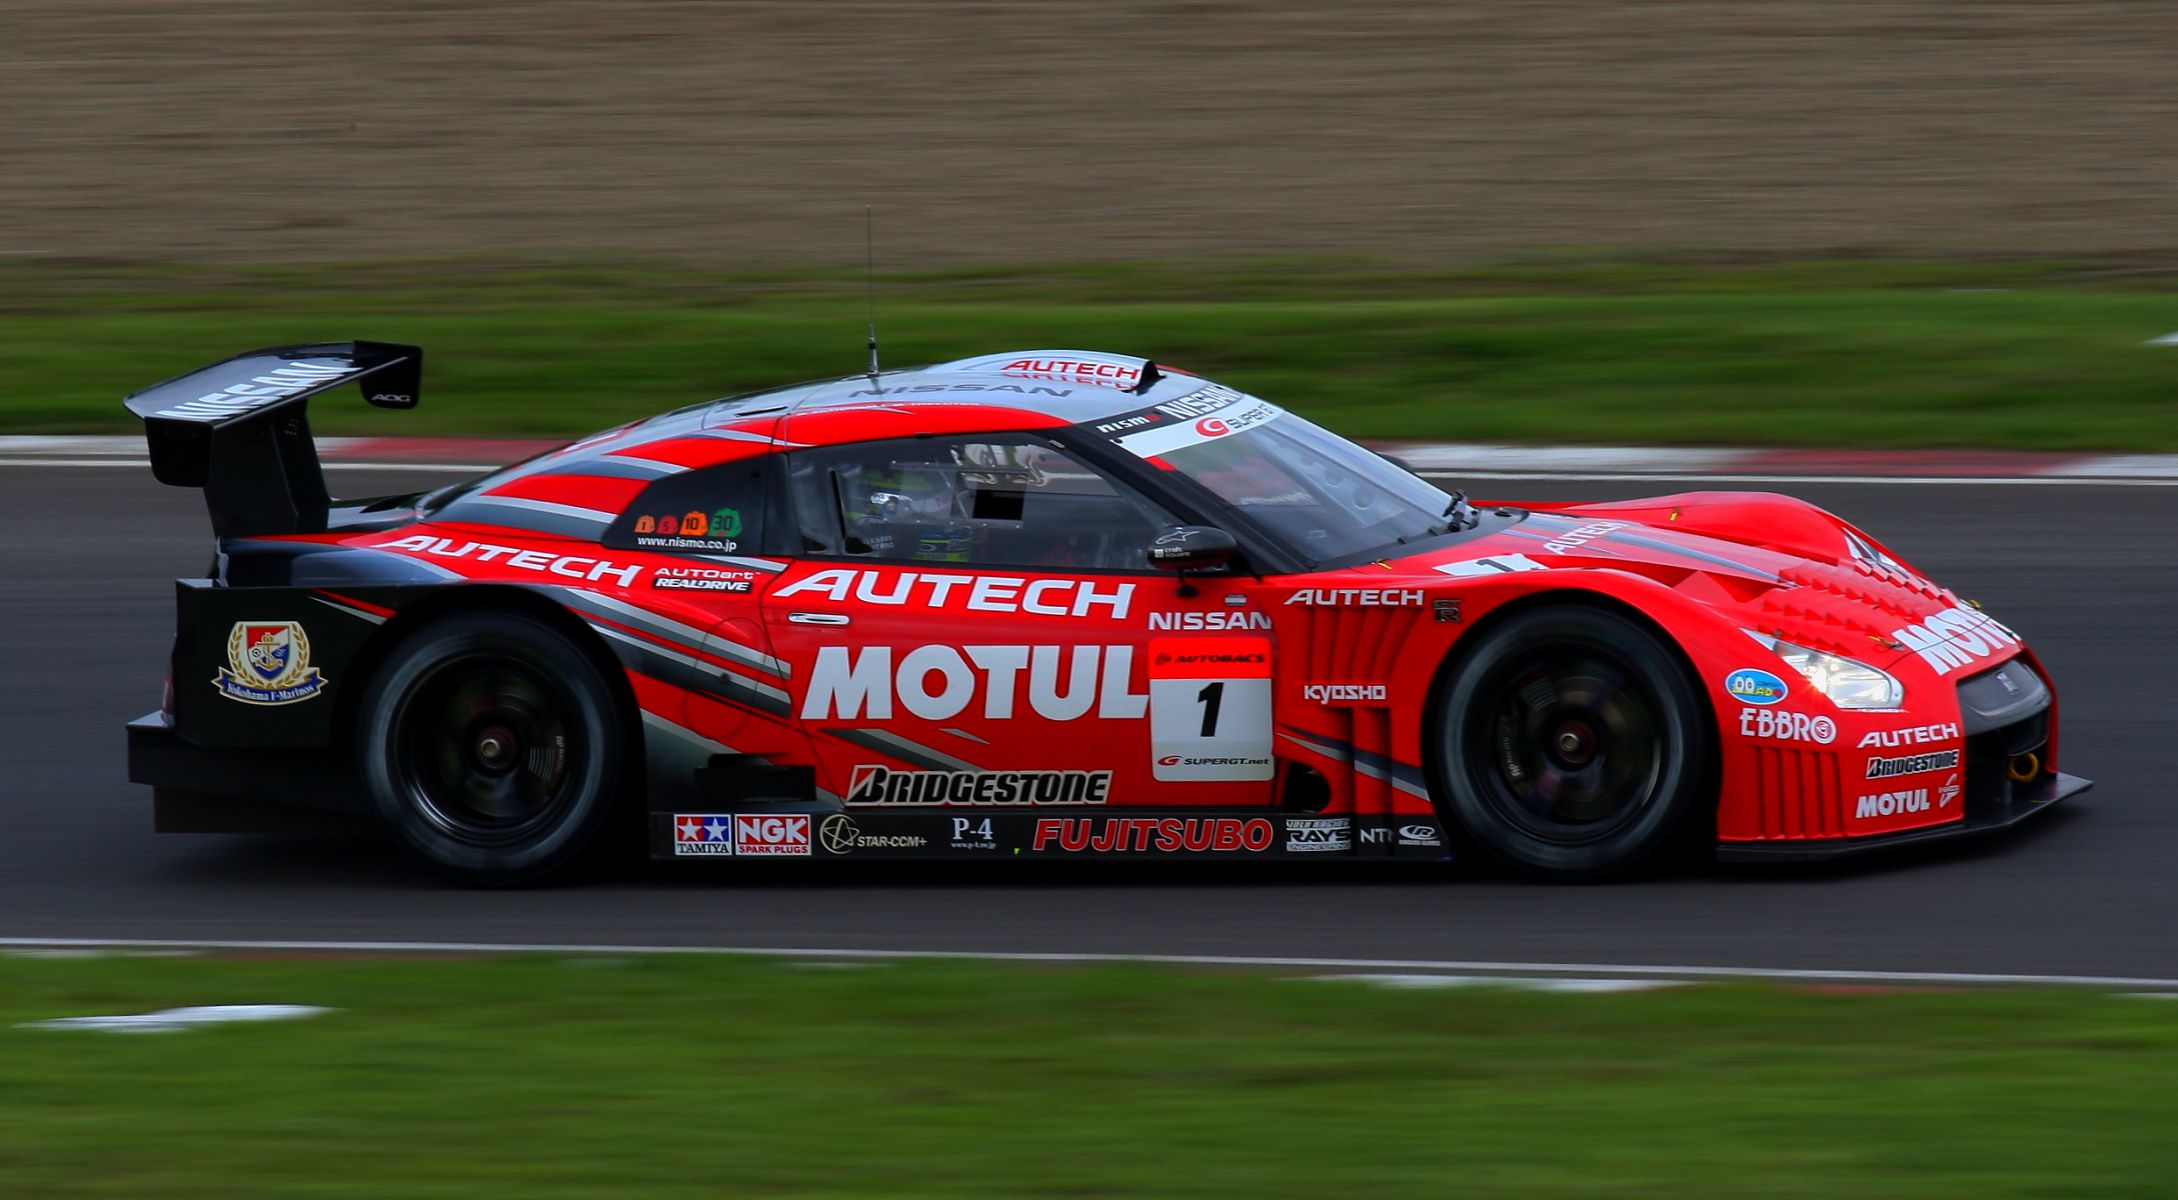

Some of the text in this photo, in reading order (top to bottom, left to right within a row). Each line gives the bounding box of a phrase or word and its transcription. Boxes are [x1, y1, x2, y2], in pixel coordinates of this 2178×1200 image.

[1001, 360, 1140, 379] AUTECH
[156, 362, 363, 420] NISSAN
[848, 384, 1073, 398] NISSAN
[1096, 383, 1241, 433] nismo NISSAN
[685, 517, 698, 530] 10
[713, 515, 733, 531] 30
[638, 537, 737, 552] www.nismo.co.jp
[1543, 521, 1632, 555] AUTECH
[371, 535, 644, 587] AUTECH
[1476, 559, 1515, 573] 1
[655, 578, 750, 591] REALDRIVE
[772, 570, 1136, 619] AUTECH
[1284, 589, 1424, 605] AUTECH
[1149, 612, 1272, 630] NISSAN
[1175, 654, 1265, 663] AUTOBACS
[800, 644, 1149, 721] MOTUL
[1304, 685, 1387, 704] KYOSHO
[1197, 682, 1225, 737] 1
[1739, 708, 1837, 744] EBBRO
[1856, 723, 1959, 748] AUTECH
[1184, 757, 1269, 766] SUPERGT.net
[1866, 749, 1960, 779] BRIDGESTONE
[845, 764, 1113, 807] BRIDGESTONE
[1856, 789, 1931, 818] MOTUL
[738, 818, 807, 843] NGK
[952, 817, 993, 840] P-4
[1032, 818, 1273, 851] FUJITSUBO
[1291, 829, 1351, 842] RAYS
[678, 843, 729, 854] TAMIYA
[739, 845, 808, 854] SPARK PLUGS
[857, 835, 928, 847] STAR-CCM+
